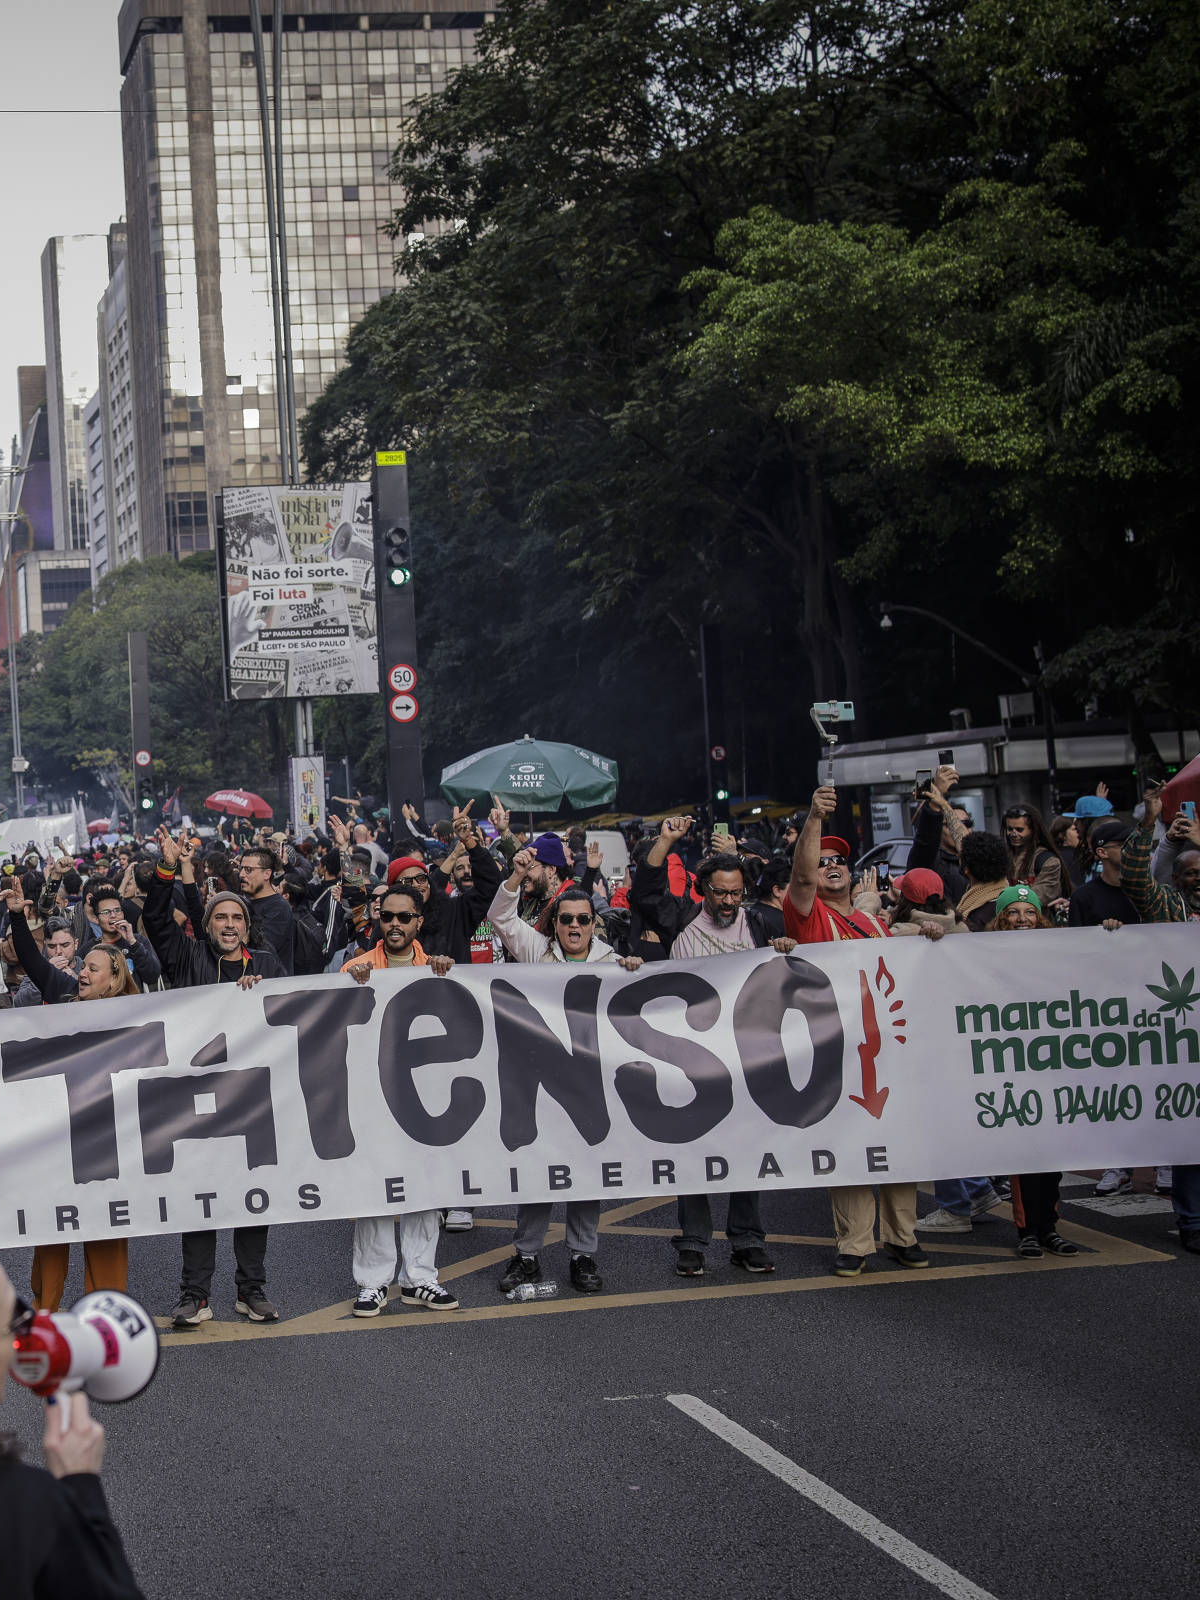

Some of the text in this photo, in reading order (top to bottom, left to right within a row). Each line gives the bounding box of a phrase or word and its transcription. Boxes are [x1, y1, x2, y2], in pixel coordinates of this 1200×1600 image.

[252, 566, 349, 580] Não foi sorte.
[253, 588, 307, 600] Foi luta
[300, 640, 318, 648] SÃO
[394, 670, 412, 684] 50
[955, 990, 1161, 1033] marcha da
[1, 1020, 278, 1184] TÁ
[974, 1082, 1043, 1128] SÃO
[1053, 1083, 1143, 1125] PAULO
[385, 1176, 406, 1204] E
[462, 1145, 889, 1195] LIBERDADE
